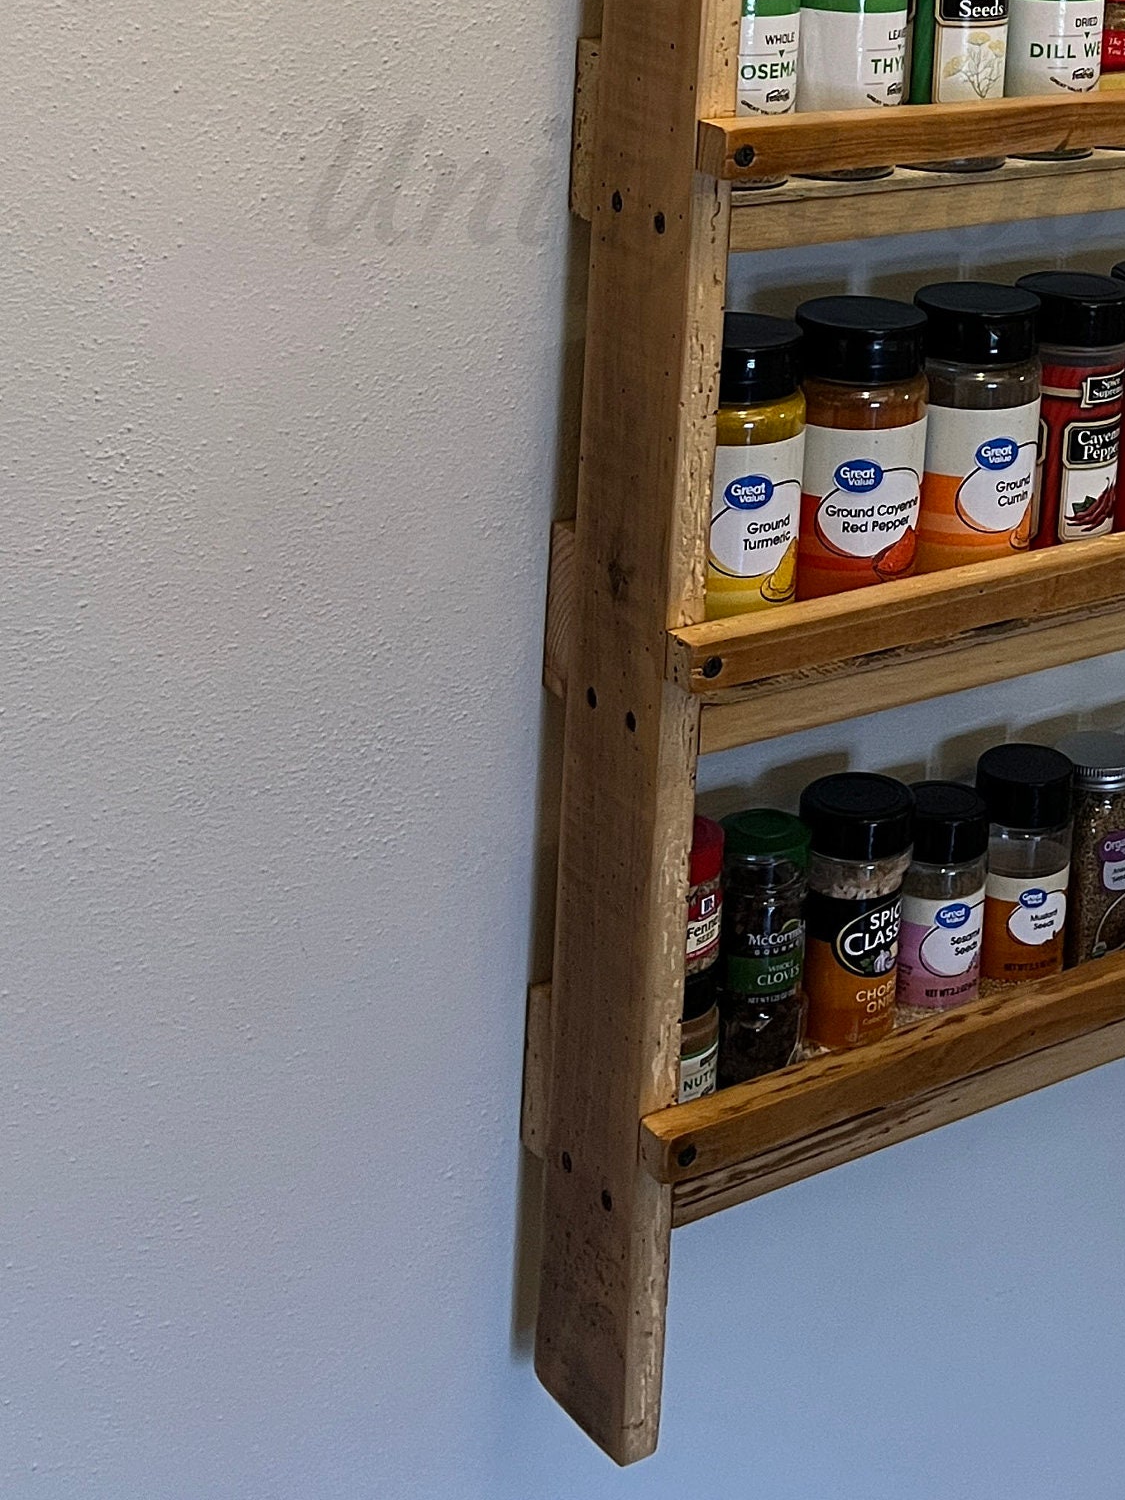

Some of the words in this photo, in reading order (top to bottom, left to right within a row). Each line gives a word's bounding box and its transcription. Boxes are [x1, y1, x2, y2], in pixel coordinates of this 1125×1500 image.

[958, 0, 1004, 18] Seeds
[1075, 17, 1098, 28] DRIED
[765, 32, 795, 45] WHOLE
[1029, 43, 1077, 59] DILL
[981, 444, 1012, 457] Great
[989, 455, 1012, 464] Value
[839, 467, 875, 481] Great
[848, 477, 875, 487] Value
[995, 472, 1031, 492] Ground
[730, 483, 766, 500] Great
[739, 492, 766, 504] Value
[997, 491, 1028, 507] Cumin
[825, 504, 875, 519] Ground
[747, 513, 791, 535] Ground
[842, 520, 868, 534] Red
[871, 515, 911, 534] Pepper
[743, 530, 791, 552] Turmeric
[940, 907, 966, 919] Great
[757, 965, 800, 986] CLOVES
